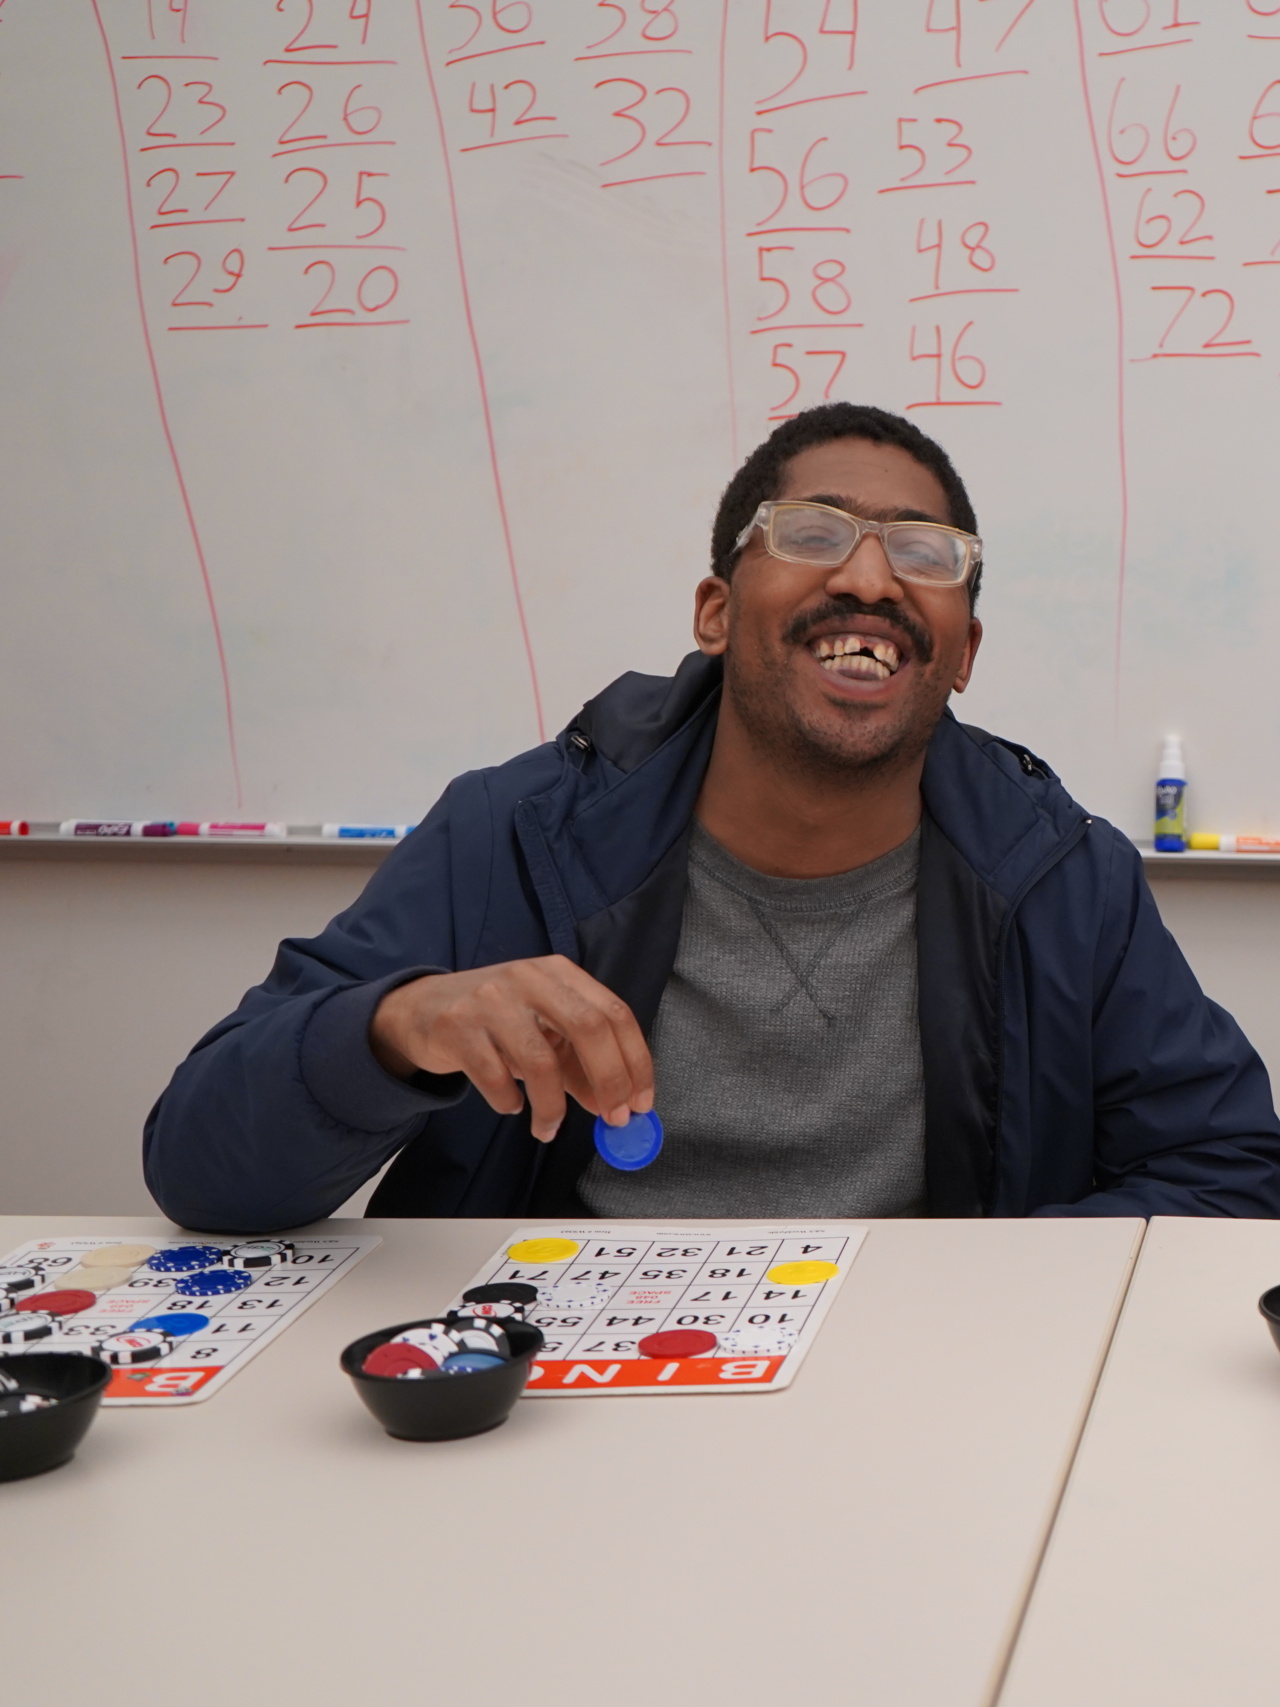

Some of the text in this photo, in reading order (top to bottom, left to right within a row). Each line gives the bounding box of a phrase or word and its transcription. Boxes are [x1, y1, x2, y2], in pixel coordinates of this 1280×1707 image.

[755, 0, 859, 105] 54
[136, 74, 227, 138] 23
[276, 80, 382, 145] 26
[467, 78, 558, 139] 42
[593, 77, 713, 167] 32
[1107, 76, 1197, 165] 66
[898, 116, 973, 182] 53
[748, 127, 848, 227] 56
[145, 167, 237, 215] 27
[283, 166, 391, 239] 25
[1134, 188, 1214, 248] 62
[916, 217, 995, 290] 48
[162, 247, 244, 308] 29
[756, 245, 851, 321] 58
[302, 260, 399, 317] 20
[1149, 285, 1253, 350] 72
[909, 320, 986, 404] 46
[769, 342, 847, 411] 57
[595, 1246, 638, 1257] 51
[656, 1247, 702, 1258] 32
[726, 1245, 769, 1257] 21
[800, 1245, 823, 1255] 4
[291, 1254, 334, 1265] 10
[508, 1269, 550, 1281] 71
[571, 1270, 621, 1281] 47
[639, 1269, 688, 1280] 35
[708, 1267, 752, 1279] 18
[128, 1277, 178, 1288] 39
[264, 1275, 311, 1287] 12
[690, 1290, 738, 1302] 17
[763, 1289, 808, 1301] 14
[167, 1299, 214, 1311] 18
[238, 1299, 285, 1311] 13
[534, 1315, 583, 1328] 55
[606, 1315, 656, 1326] 44
[677, 1314, 726, 1326] 30
[748, 1313, 794, 1325] 10
[211, 1321, 256, 1335] 11
[191, 1346, 219, 1360] 8
[583, 1340, 636, 1353] 37
